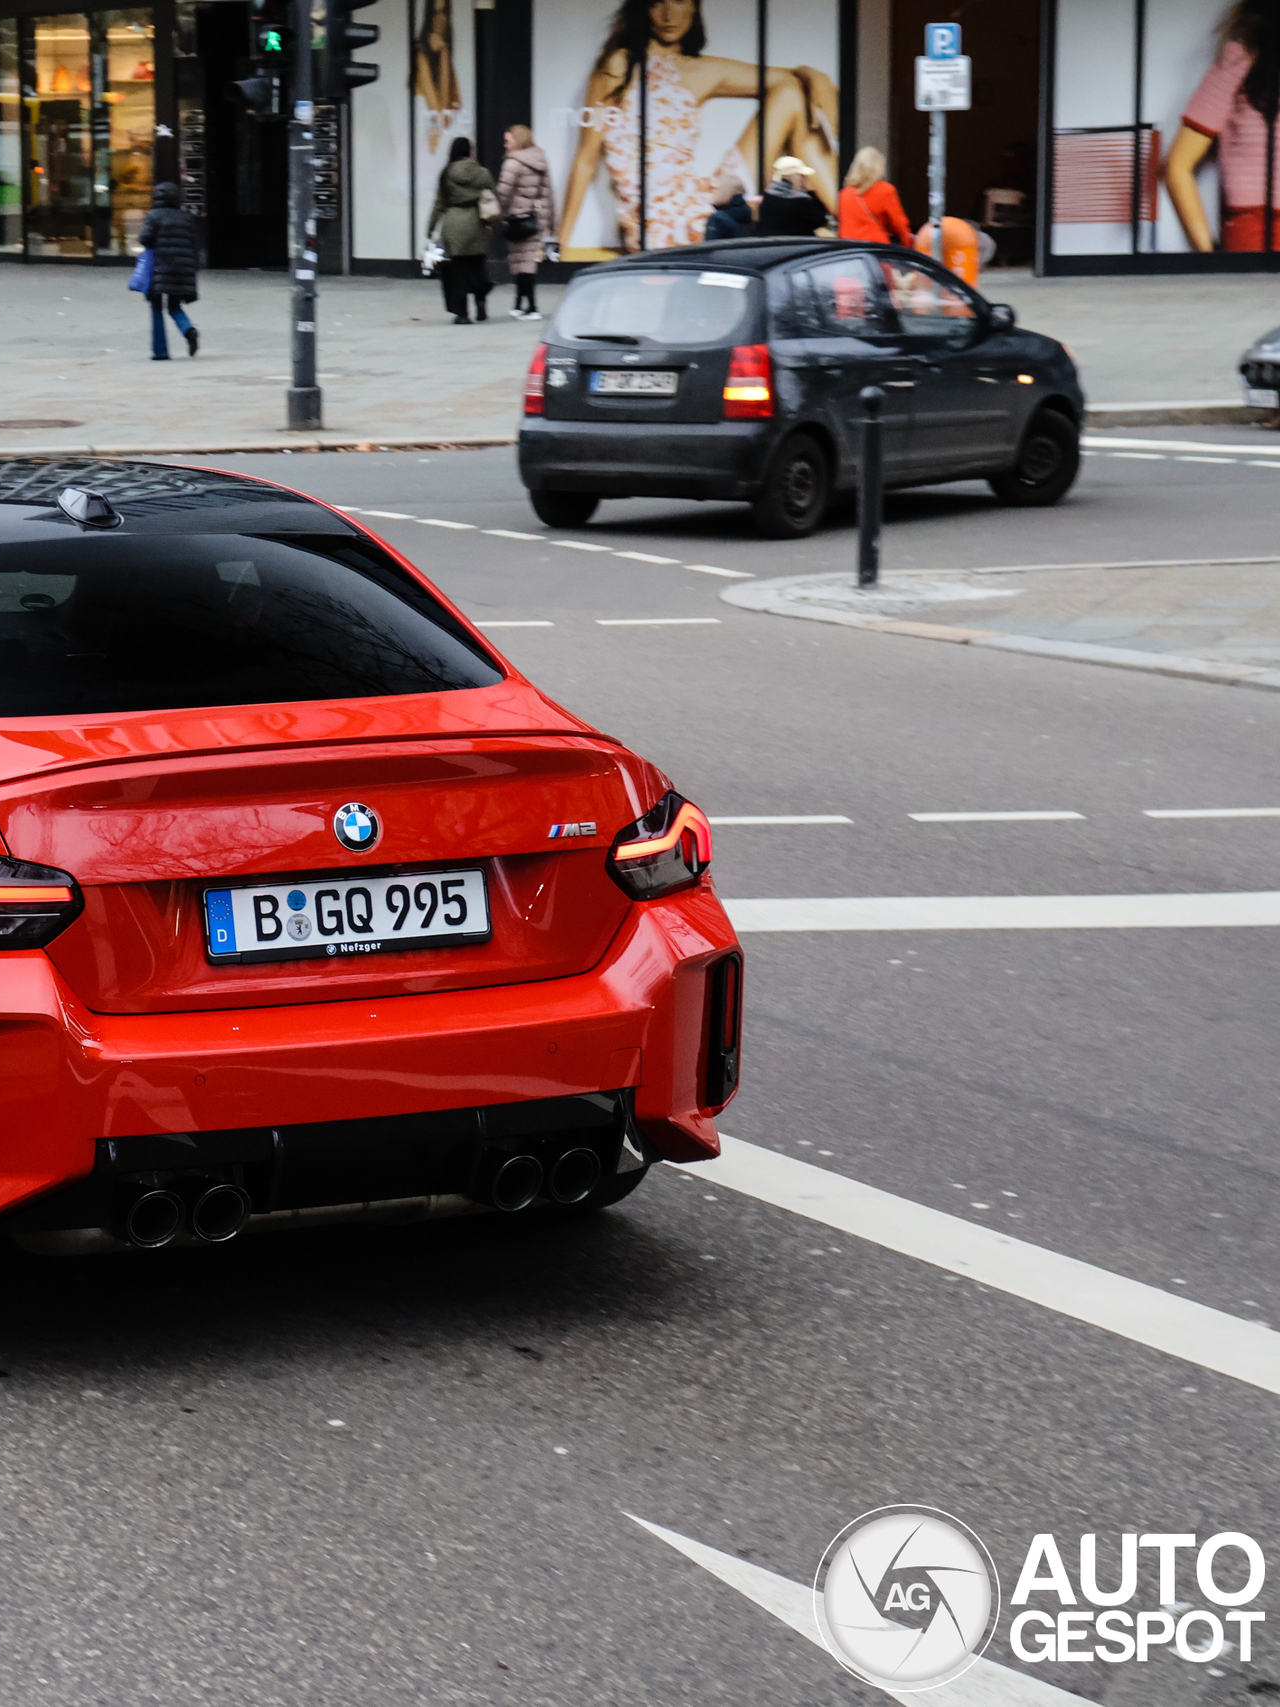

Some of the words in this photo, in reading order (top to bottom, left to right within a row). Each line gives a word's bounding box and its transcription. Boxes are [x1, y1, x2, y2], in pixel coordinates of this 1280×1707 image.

[337, 804, 375, 821] BMW
[562, 821, 597, 837] M2
[253, 894, 283, 941] B
[314, 887, 375, 937] GQ
[385, 879, 468, 931] 995
[217, 928, 228, 943] D
[340, 942, 382, 953] Nefzger
